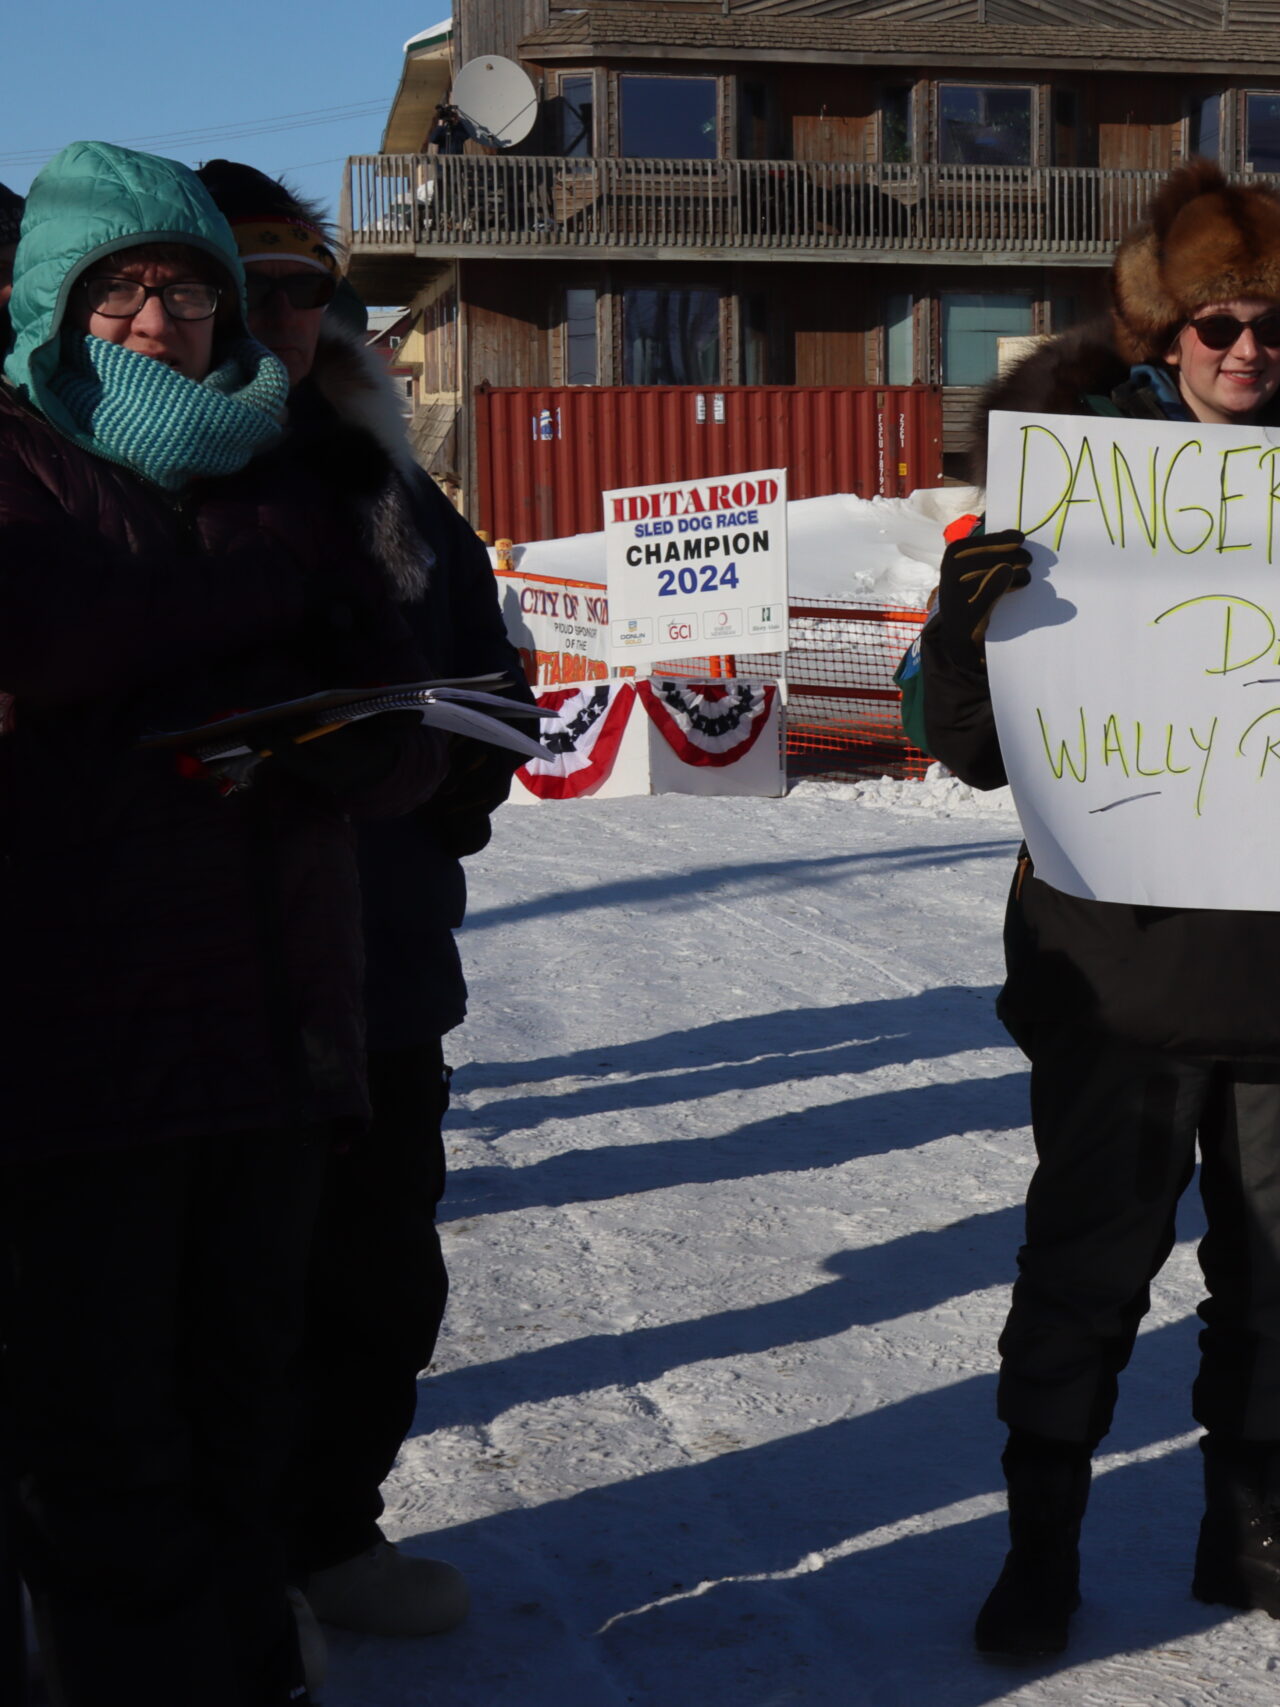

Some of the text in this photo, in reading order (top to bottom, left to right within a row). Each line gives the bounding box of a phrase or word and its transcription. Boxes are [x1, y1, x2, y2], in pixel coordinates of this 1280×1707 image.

[611, 479, 778, 523] IDITAROD
[634, 510, 759, 538] SLED DOG RACE
[626, 530, 770, 567] CHAMPION
[657, 562, 739, 596] 2024
[520, 587, 559, 617] CITY
[565, 638, 575, 649] OF
[669, 624, 692, 640] GCI
[1036, 706, 1218, 817] WALLY
